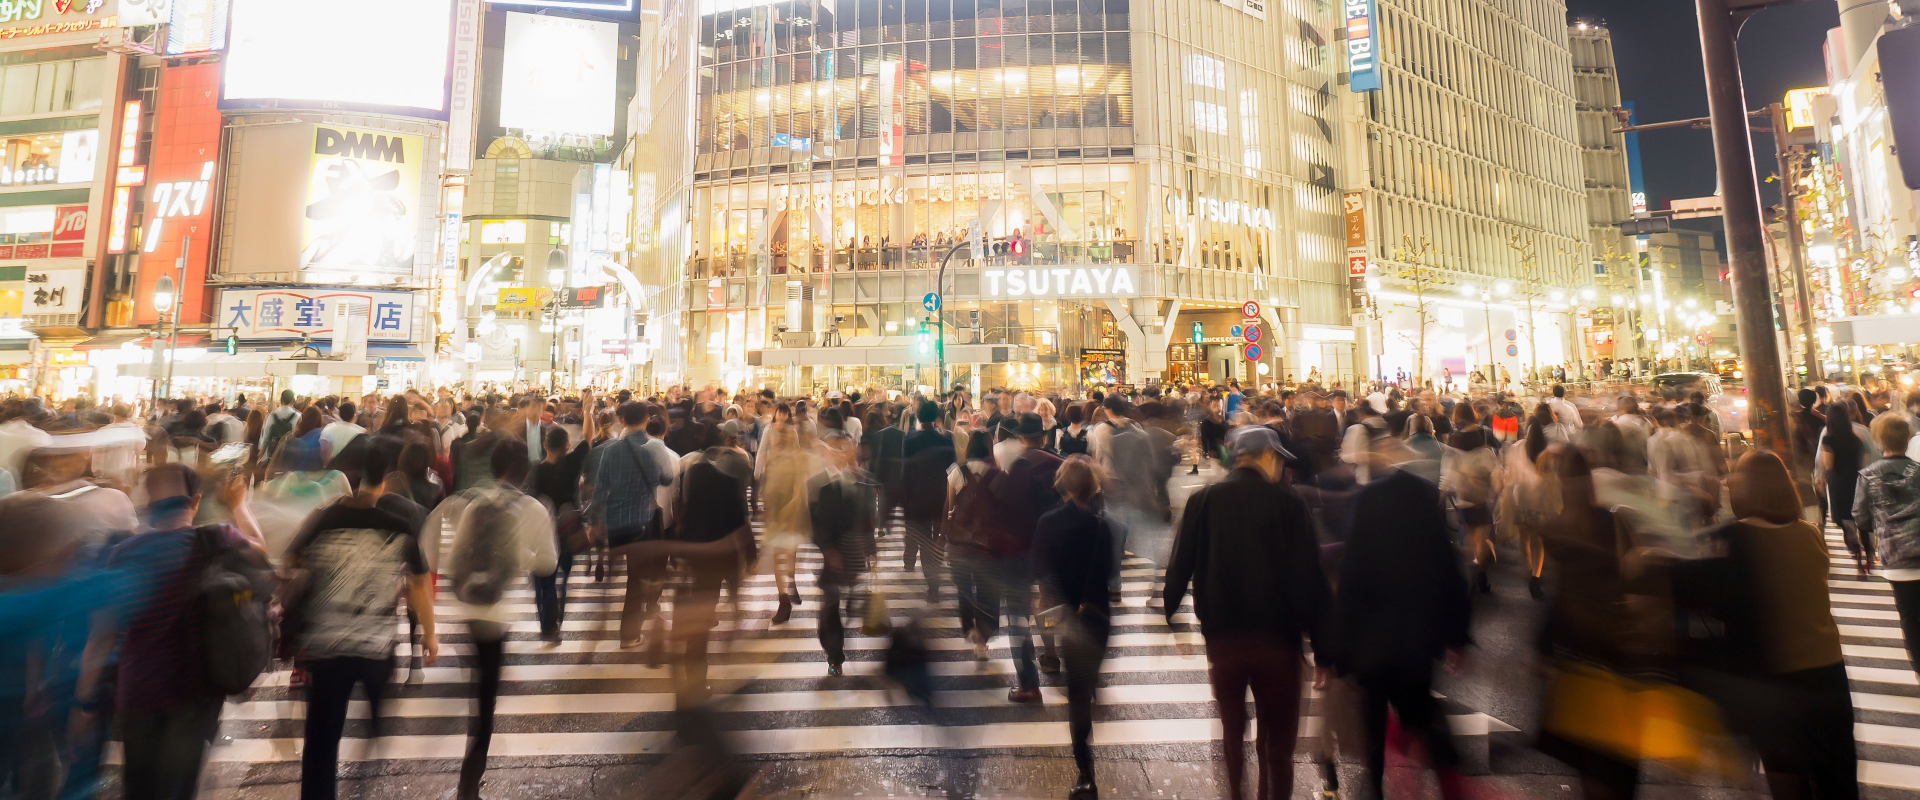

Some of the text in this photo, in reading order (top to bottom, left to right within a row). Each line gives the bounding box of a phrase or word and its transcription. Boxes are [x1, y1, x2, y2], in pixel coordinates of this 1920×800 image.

[453, 50, 469, 111] neon
[323, 100, 343, 109] DHC
[315, 127, 405, 164] DMM
[775, 186, 910, 212] STARBUCKS
[1197, 196, 1275, 231] TSUTAYA
[55, 210, 87, 236] JTB
[1351, 258, 1365, 273] 本
[985, 267, 1134, 296] TSUTAYA
[228, 298, 403, 332] 大盛堂店
